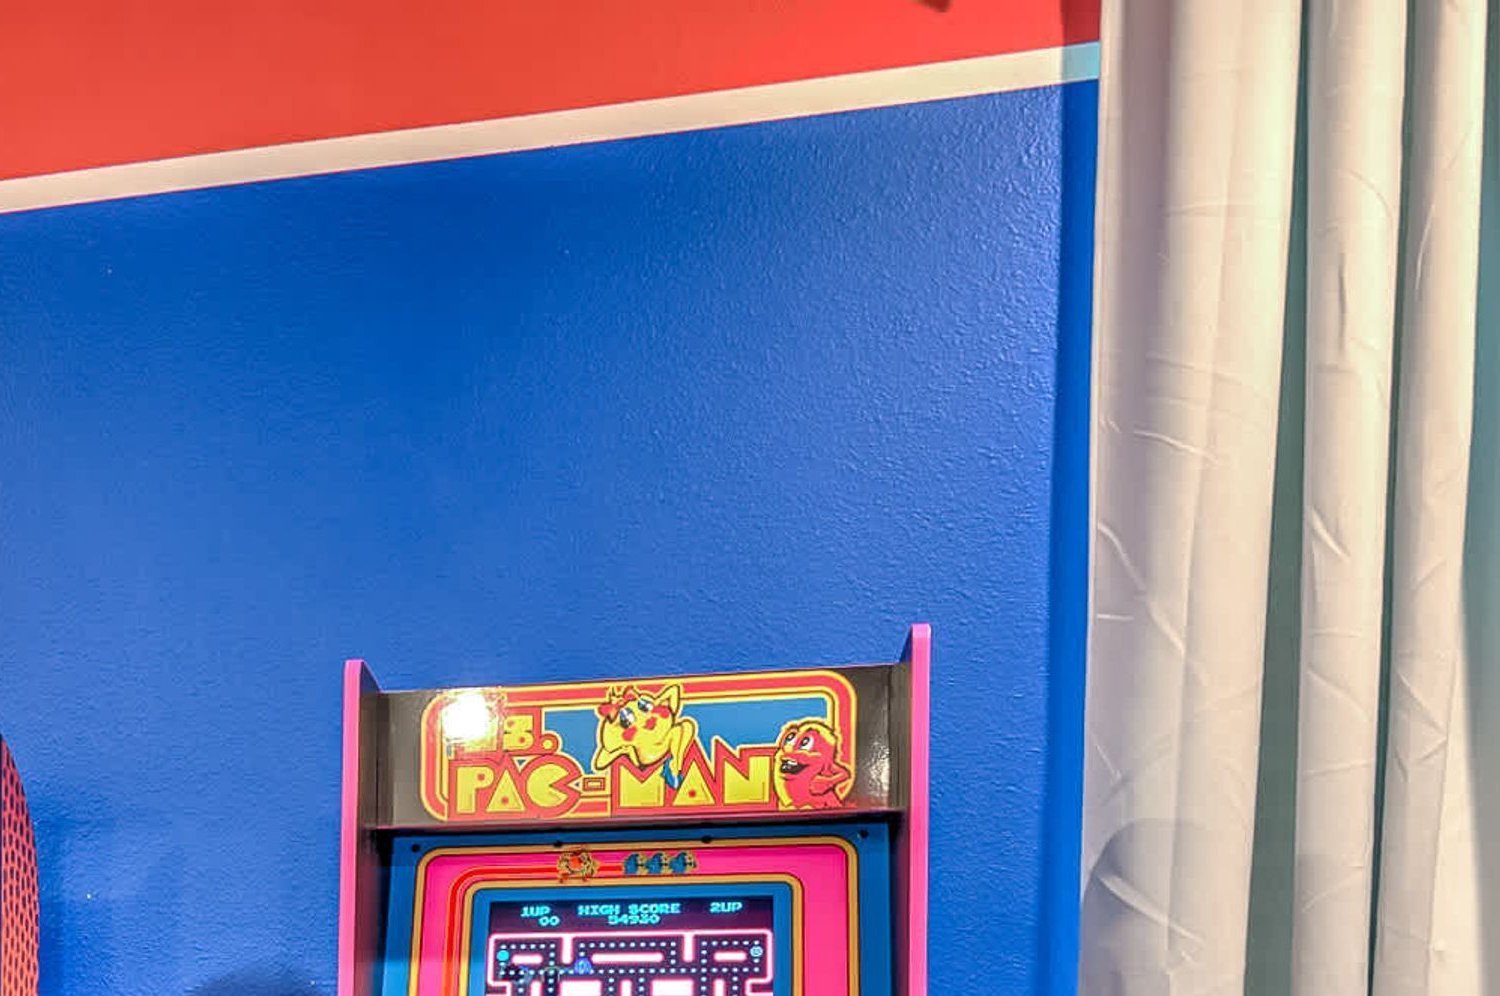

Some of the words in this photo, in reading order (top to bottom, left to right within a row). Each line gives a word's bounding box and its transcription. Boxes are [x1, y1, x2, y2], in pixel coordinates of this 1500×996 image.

[454, 752, 772, 816] PAC-MAN
[520, 906, 551, 917] 1UP
[577, 904, 620, 916] HIGH
[628, 903, 681, 915] SCORE
[709, 902, 743, 913] 2UP
